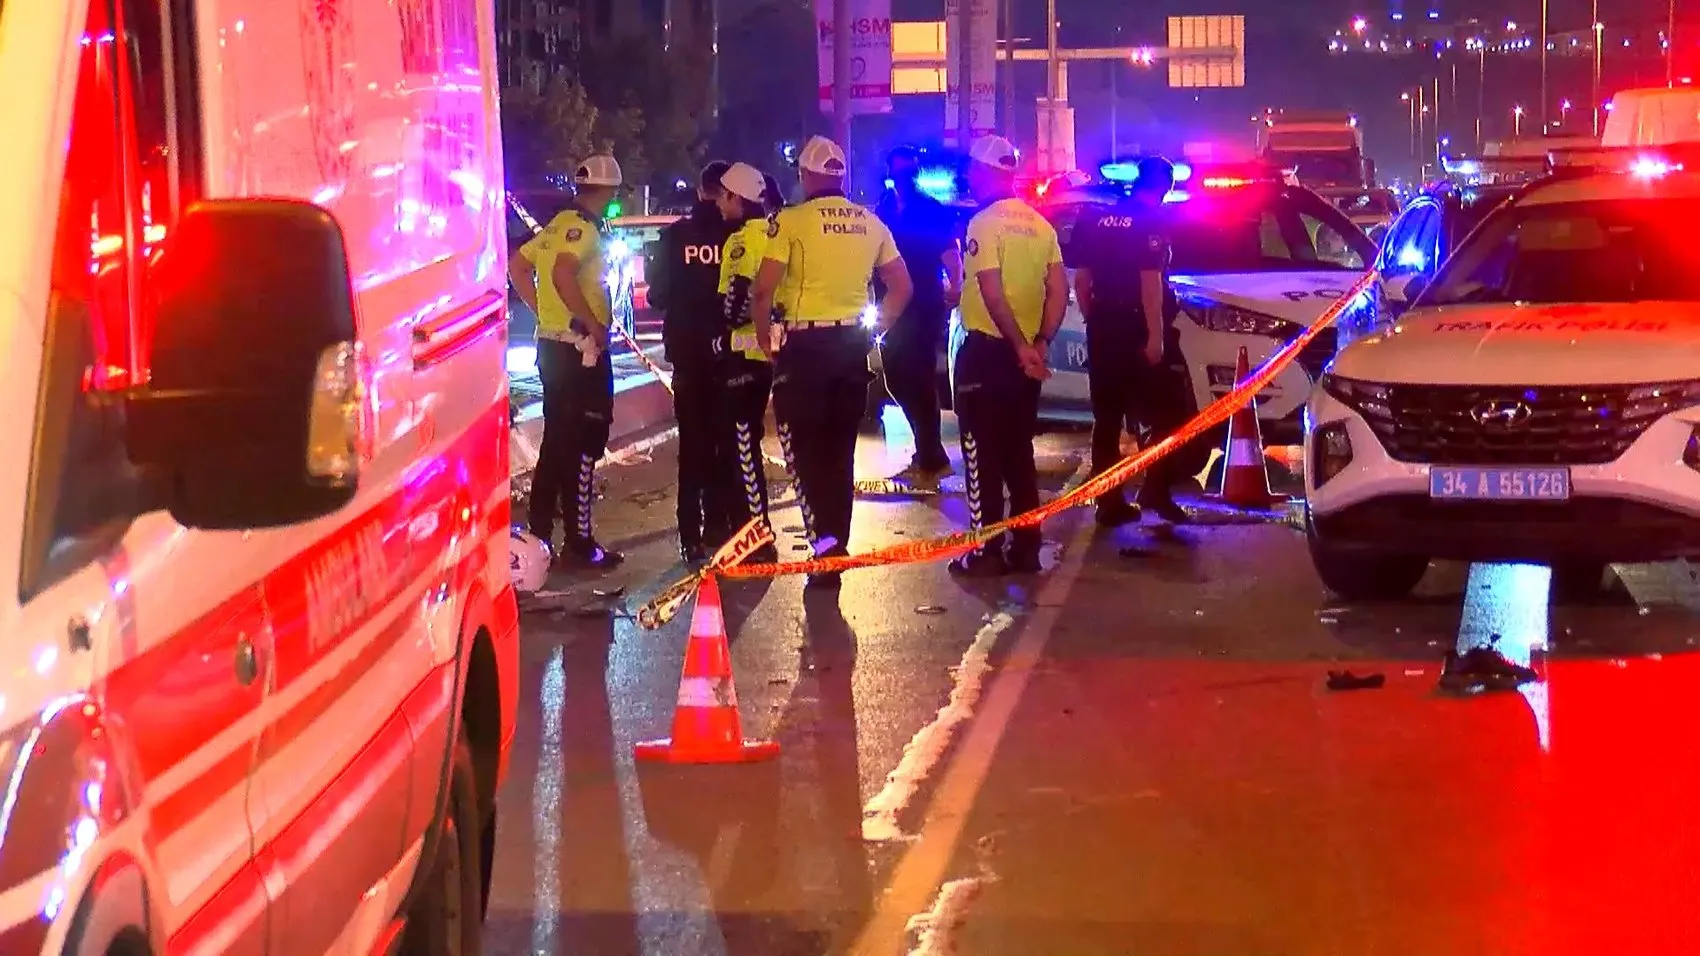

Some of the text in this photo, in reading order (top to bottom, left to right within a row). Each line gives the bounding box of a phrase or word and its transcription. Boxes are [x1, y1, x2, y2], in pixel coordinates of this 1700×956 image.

[1442, 471, 1563, 497] 34 A 55126
